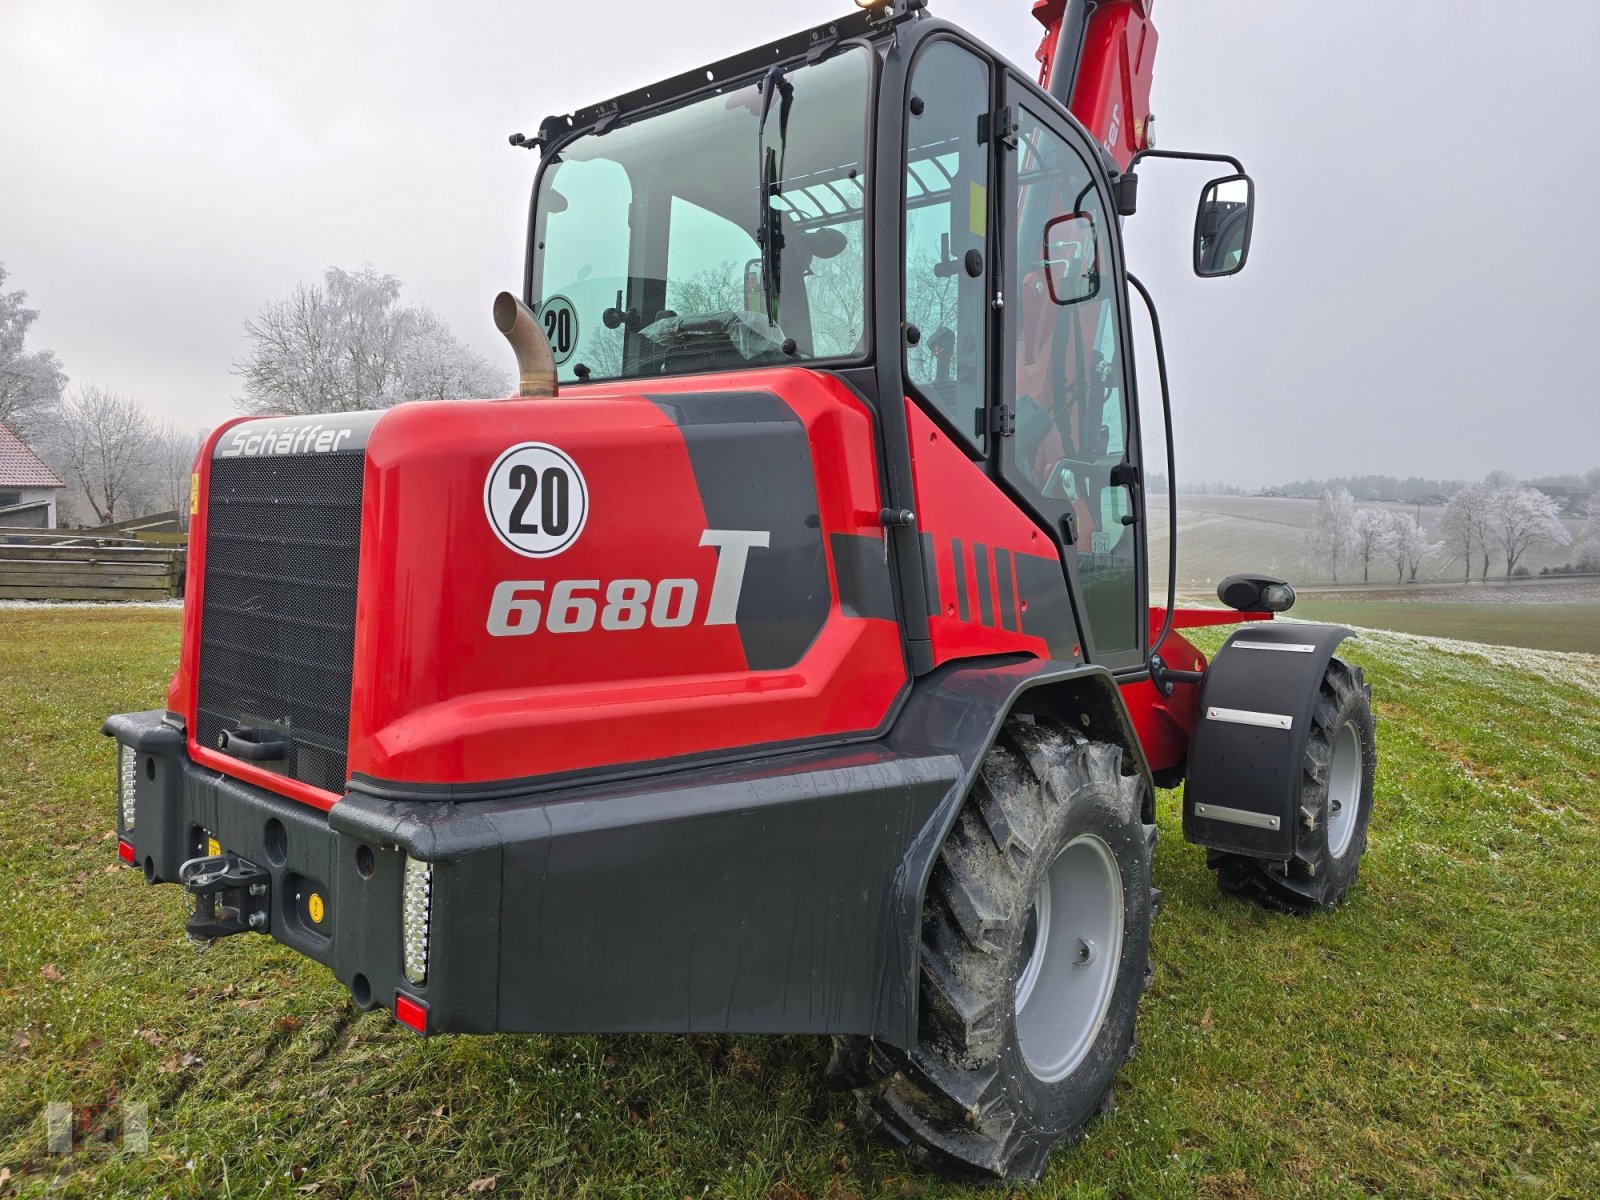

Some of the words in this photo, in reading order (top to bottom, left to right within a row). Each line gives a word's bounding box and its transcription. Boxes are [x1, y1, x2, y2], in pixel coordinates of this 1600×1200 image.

[544, 308, 571, 353] 20
[221, 424, 352, 457] Schäffer
[508, 464, 569, 537] 20
